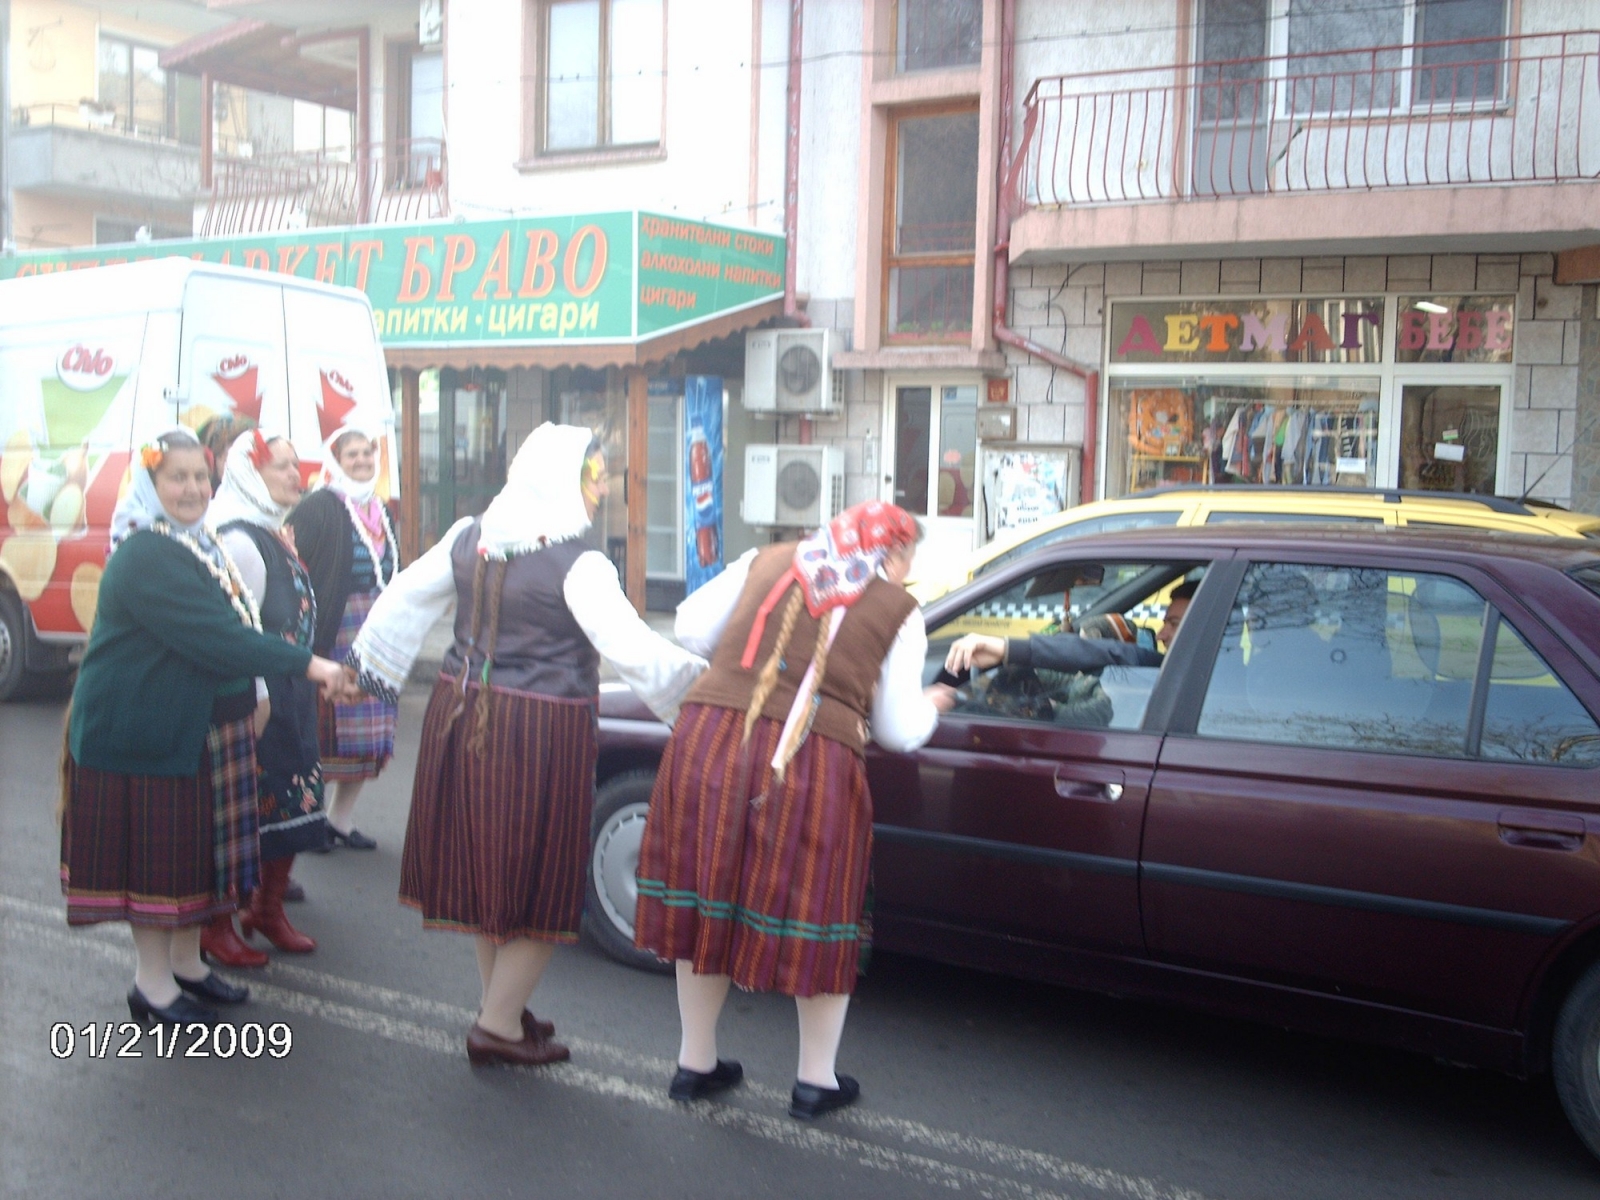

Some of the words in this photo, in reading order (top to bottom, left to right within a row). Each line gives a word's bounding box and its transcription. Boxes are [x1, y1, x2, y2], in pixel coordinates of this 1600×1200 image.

[641, 216, 731, 248] хранителни
[735, 232, 774, 256] стоки
[397, 224, 608, 303] БРАВО
[641, 250, 721, 278] алкохолни
[724, 264, 781, 289] напитки
[641, 285, 696, 312] цигари
[372, 306, 468, 336] апитки
[488, 301, 600, 337] цигари
[1117, 313, 1379, 356] ДЕТМАГ
[1400, 311, 1512, 350] БЕБЕ
